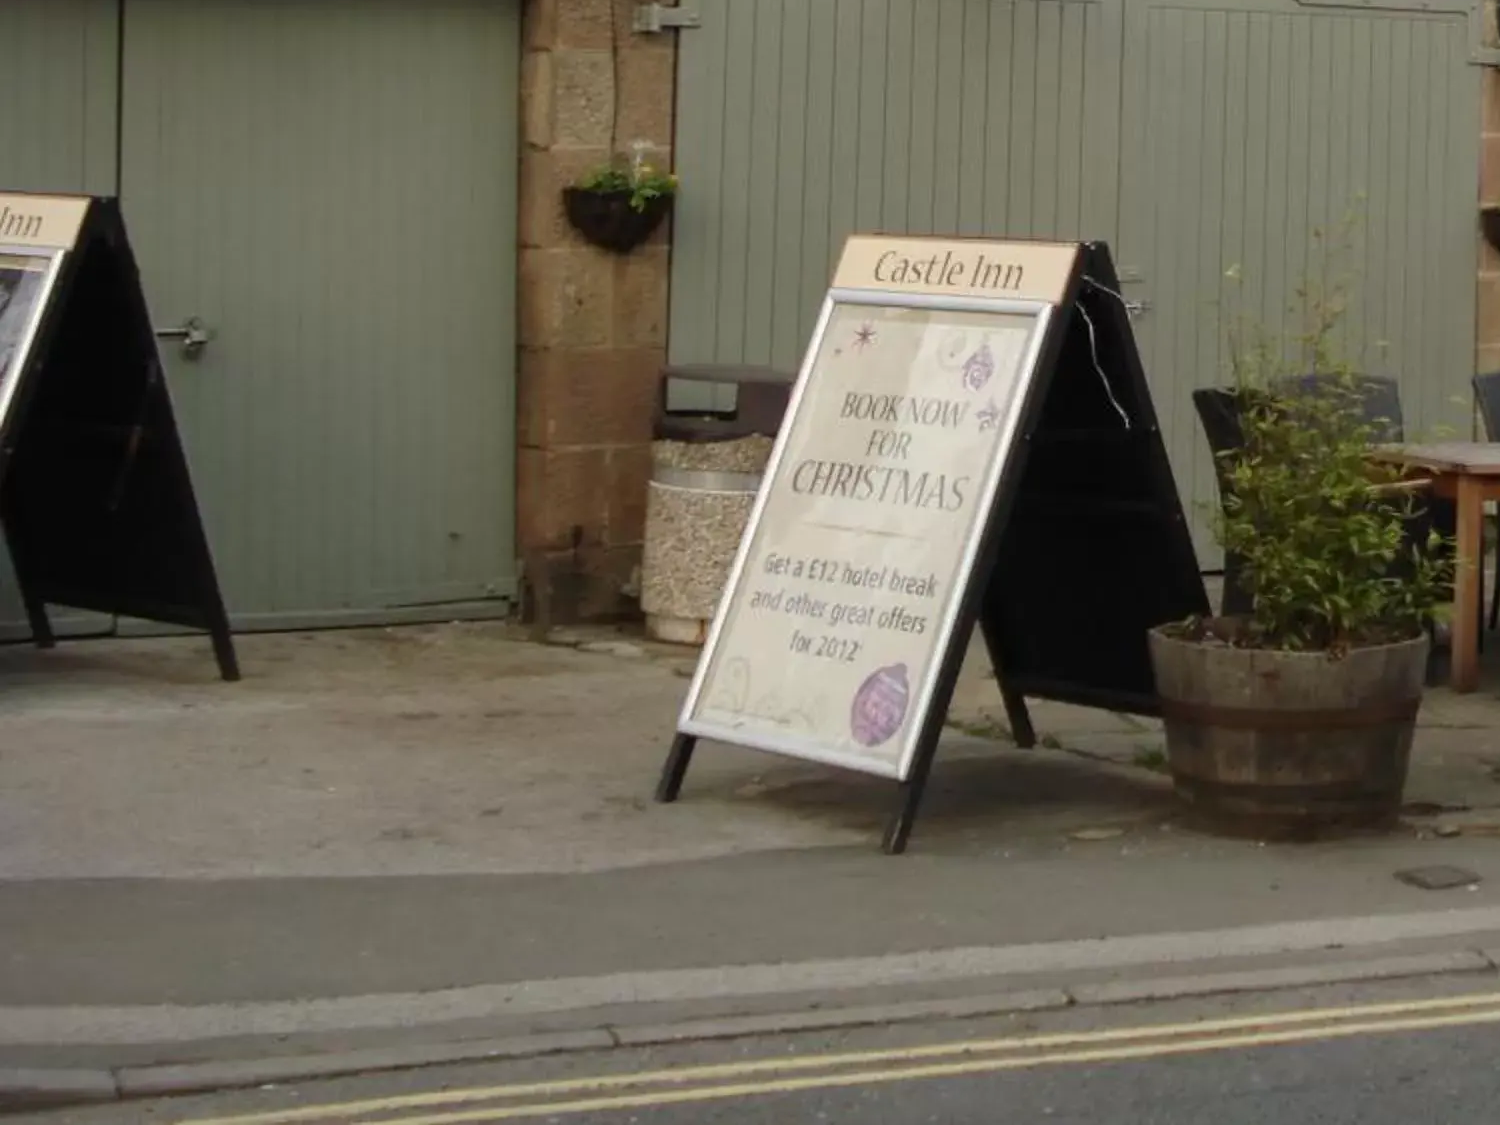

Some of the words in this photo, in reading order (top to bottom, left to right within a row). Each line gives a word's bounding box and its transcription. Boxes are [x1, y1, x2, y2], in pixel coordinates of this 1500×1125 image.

[874, 250, 965, 286] Castle
[969, 254, 1024, 290] Inn
[840, 391, 904, 423] BOOK
[907, 396, 970, 429] NOW
[865, 429, 913, 459] FOR
[792, 459, 970, 512] CHRISTMAS
[764, 552, 790, 575] Get
[792, 560, 804, 577] a
[807, 558, 839, 582] £12
[841, 562, 887, 588] hotel
[889, 568, 938, 598] break
[749, 588, 785, 610] and
[785, 592, 828, 618] other
[830, 602, 875, 627] great
[877, 607, 928, 635] offers
[789, 629, 813, 652] for
